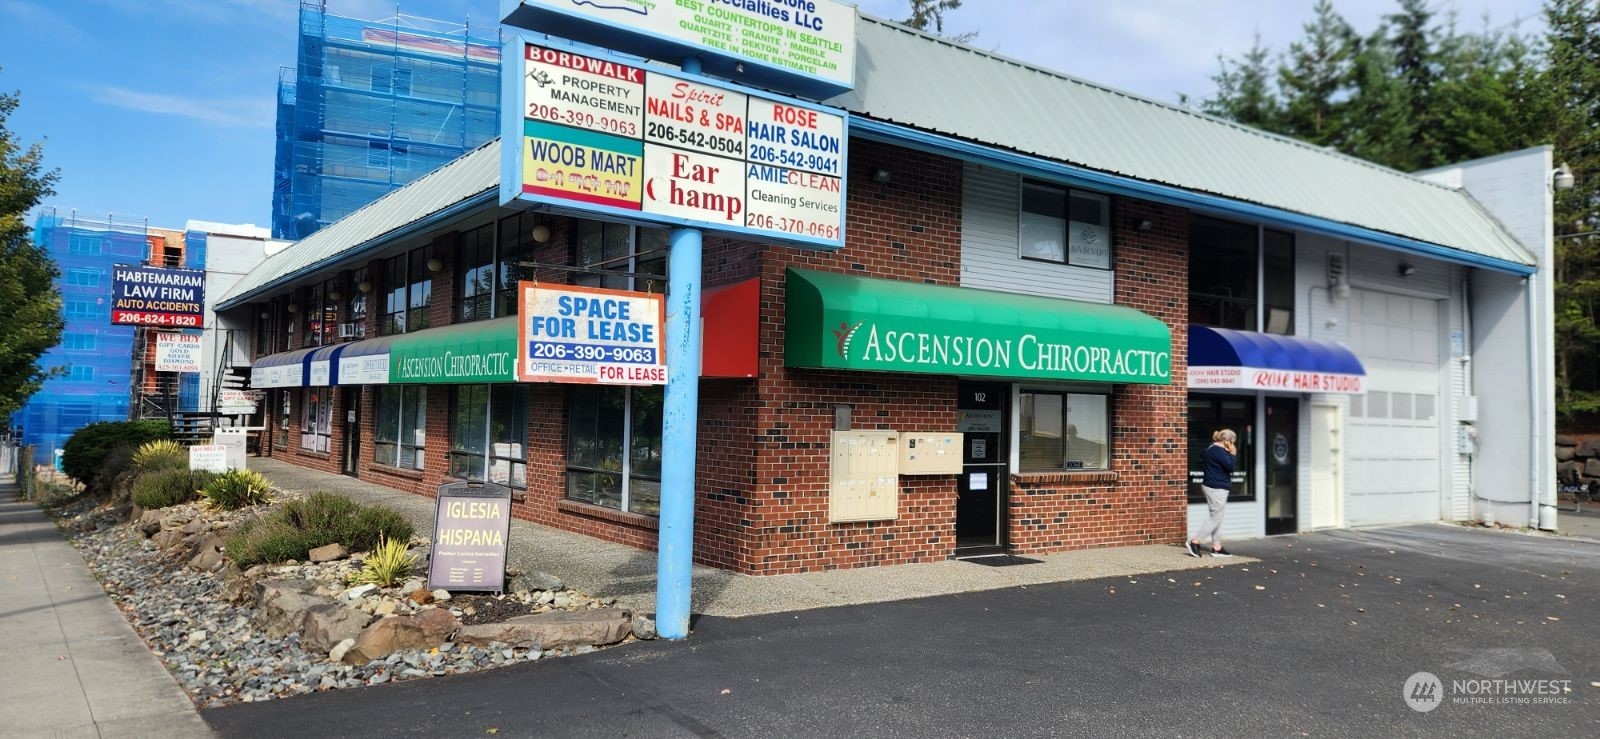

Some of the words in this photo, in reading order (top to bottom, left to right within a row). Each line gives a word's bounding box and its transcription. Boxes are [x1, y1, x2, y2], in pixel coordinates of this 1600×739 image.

[675, 0, 704, 12] BEST
[708, 6, 783, 36] COUNTERTOPS
[786, 29, 796, 40] IN
[800, 32, 842, 53] SEATTLE!
[795, 11, 823, 31] LLC
[679, 20, 732, 42] QUARTZITE
[742, 38, 778, 54] DEKTON
[788, 51, 836, 70] PORCELAIN
[694, 14, 732, 32] QUARTZ
[742, 28, 780, 46] GRANITE
[790, 42, 825, 58] MARBLE
[530, 46, 639, 82] BORDWALK
[702, 37, 726, 50] FREE
[730, 44, 739, 54] IN
[742, 48, 768, 62] HOME
[772, 56, 816, 74] ESTIMATE!
[562, 75, 630, 99] PROPERTY
[672, 82, 724, 107] Spirit
[550, 88, 640, 116] MANAGEMENT
[648, 96, 694, 126] NAILS
[700, 110, 710, 127] &
[716, 113, 744, 134] SPA
[529, 102, 636, 136] 206-390-9063
[773, 104, 818, 129] ROSE
[648, 122, 742, 155] 206-542-0504
[749, 121, 786, 144] HAIR
[791, 130, 839, 154] SALON
[530, 139, 586, 168] WOOB
[591, 150, 636, 177] MART
[672, 153, 720, 184] Ear
[750, 144, 838, 174] 206-542-9041
[748, 164, 840, 193] AMIECLEAN
[752, 190, 796, 208] Cleaning
[800, 196, 838, 213] Services
[748, 212, 840, 240] 206-370-0661
[116, 270, 202, 287] HABTEMARIAM
[124, 284, 160, 298] LAW
[162, 286, 194, 300] FIRM
[116, 299, 144, 310] AUTO
[146, 301, 200, 313] ACCIDENTS
[119, 312, 196, 326] 206-624-1820
[558, 296, 630, 320] SPACE
[160, 334, 176, 342] WE
[180, 334, 200, 342] BUY
[532, 316, 576, 338] FOR
[588, 320, 654, 343] LEASE
[534, 344, 652, 362] 206-390-9063
[862, 324, 1012, 370] ASCENSION
[1018, 334, 1168, 378] CHIROPRACTIC
[402, 356, 442, 378] ASCENSION
[444, 351, 509, 377] CHIROPRACTIC
[531, 361, 562, 373] OFFICE
[570, 364, 597, 374] RETAIL
[600, 366, 624, 380] FOR
[628, 367, 664, 381] LEASE
[1294, 374, 1319, 389] HAIR
[1323, 375, 1360, 391] STUDIO
[974, 392, 986, 402] 102
[446, 502, 500, 519] IGLESIA
[440, 528, 502, 546] HISPANA
